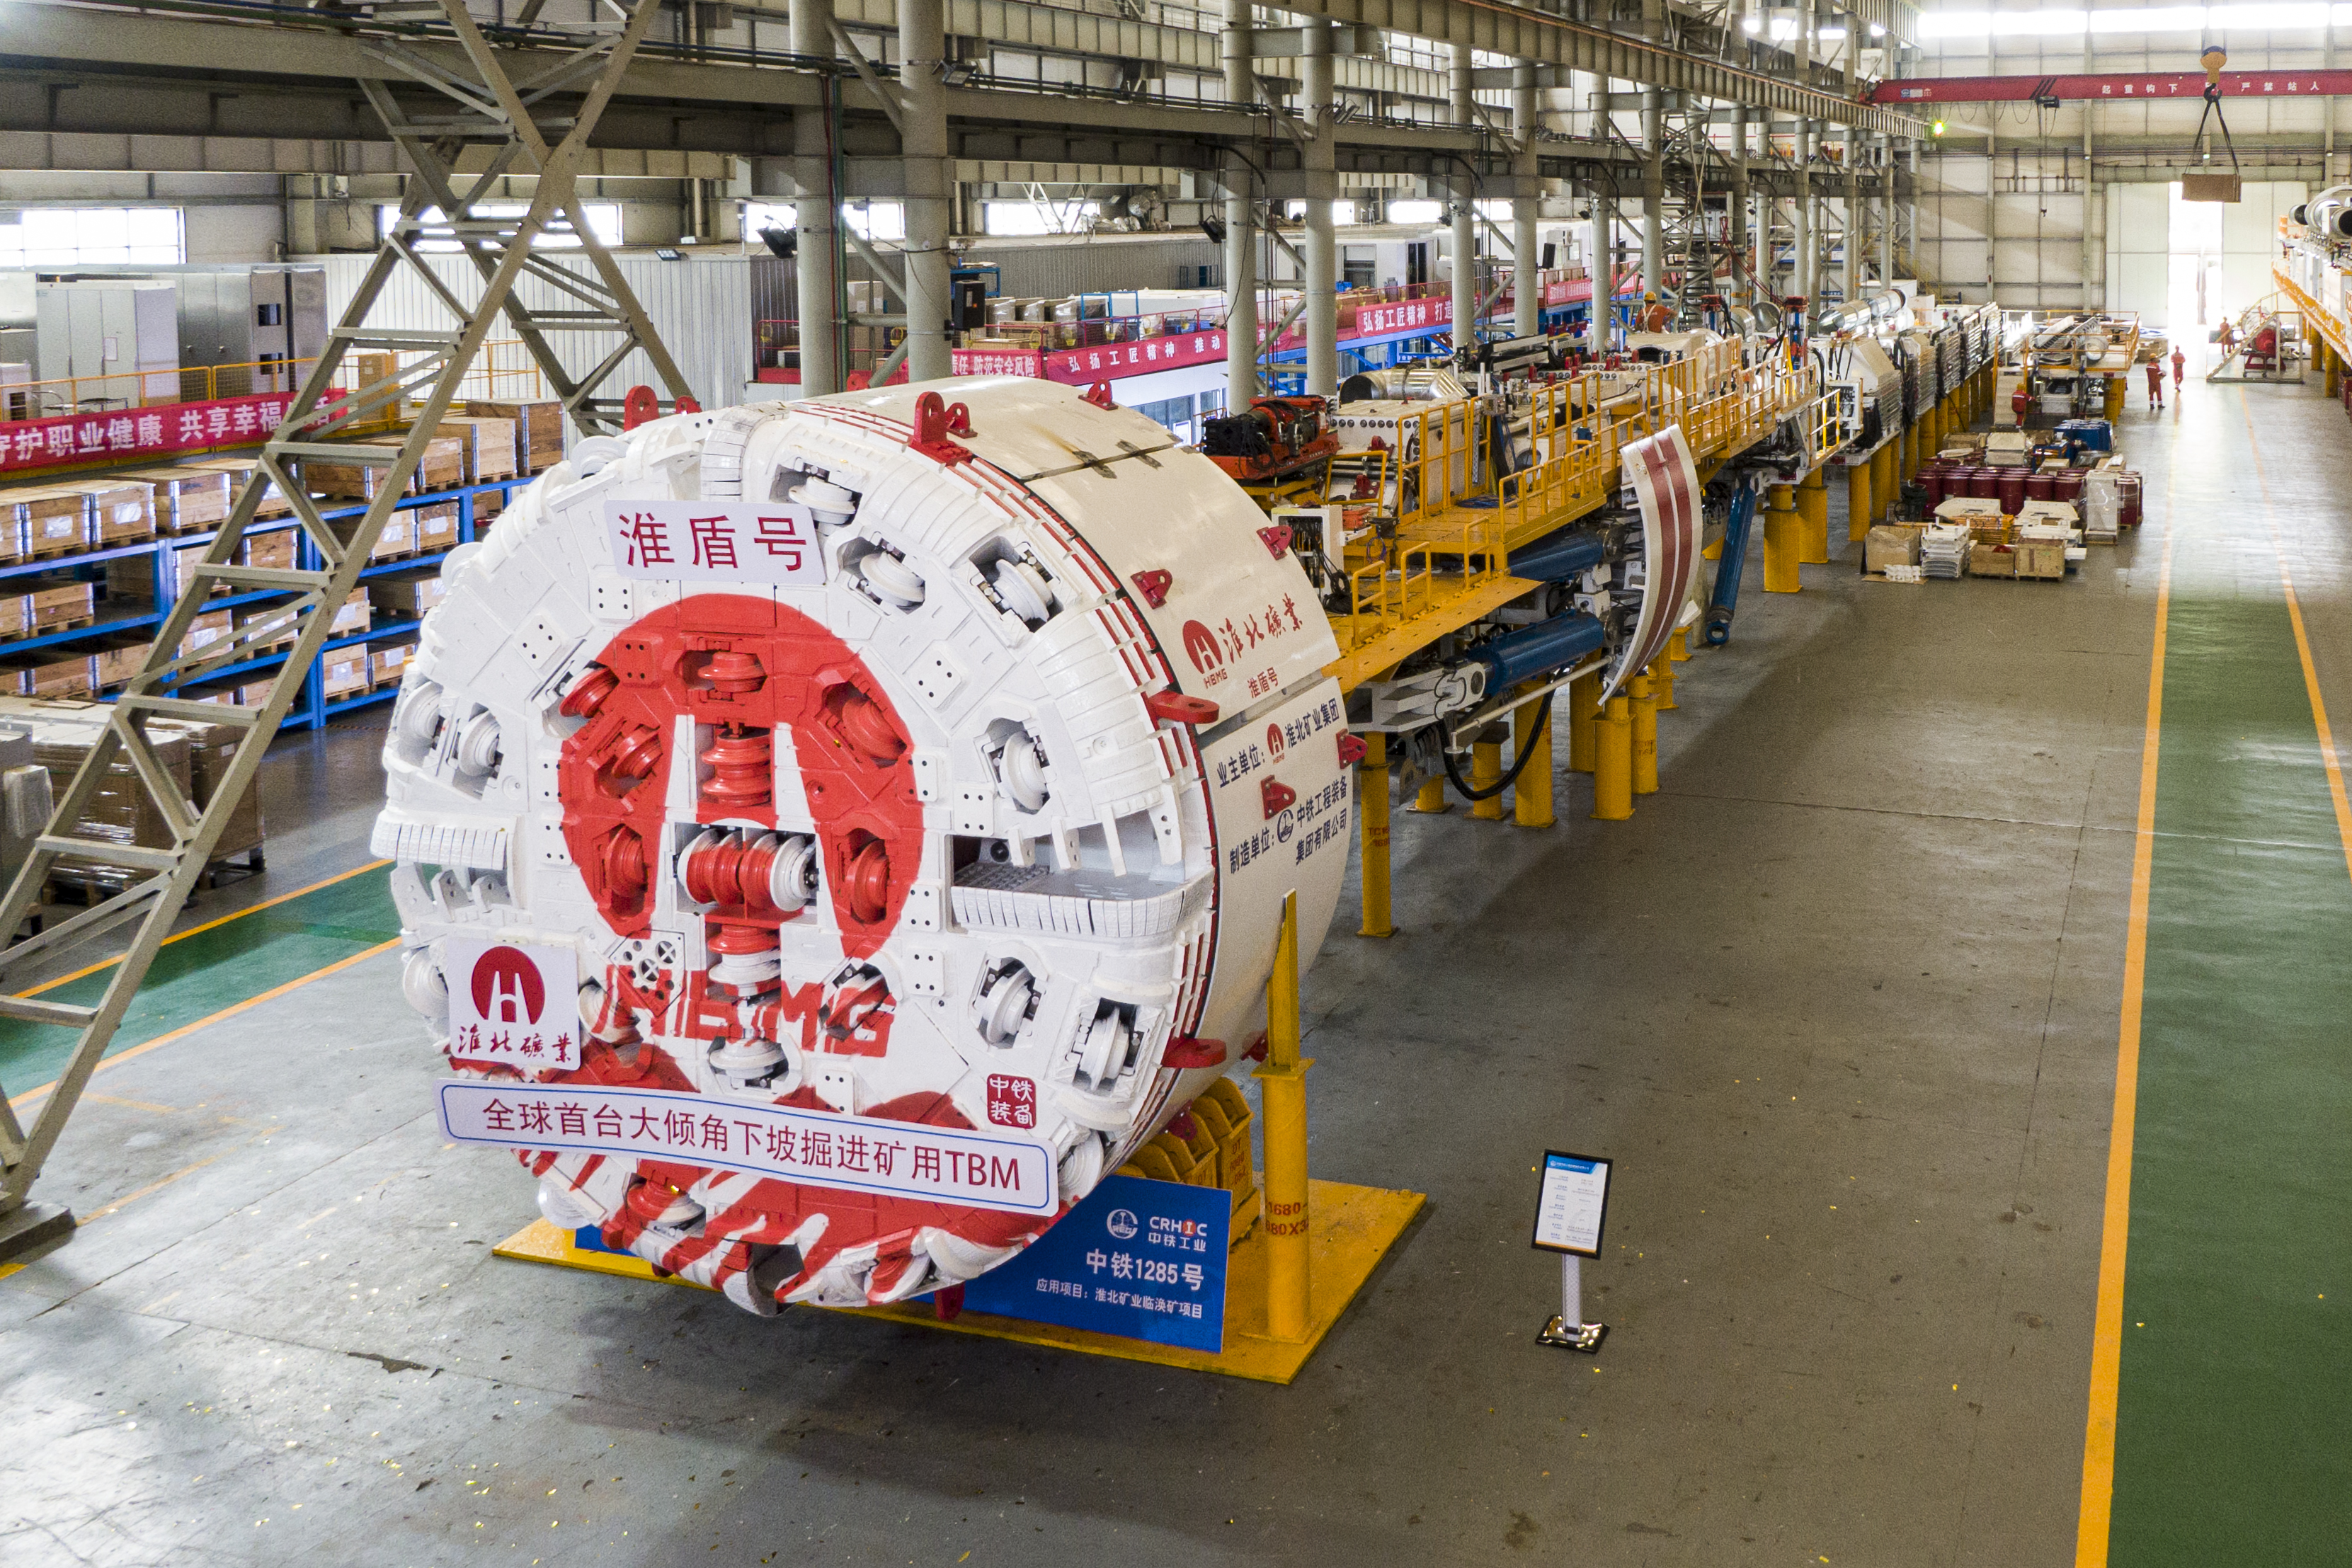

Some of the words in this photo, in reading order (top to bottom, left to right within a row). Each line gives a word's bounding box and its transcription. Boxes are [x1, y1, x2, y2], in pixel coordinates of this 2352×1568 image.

[1362, 303, 1426, 333] 弘扬工匠精神
[974, 355, 1035, 377] 防范安全风险
[1068, 341, 1175, 372] 弘扬工匠精神
[1194, 335, 1221, 353] 推动
[618, 511, 807, 572] 淮盾号
[1204, 668, 1228, 689] HBMG
[1248, 667, 1279, 699] 淮盾号
[1285, 697, 1340, 748] 淮北矿业集团
[1296, 775, 1347, 828] 中铁工程装备
[1296, 808, 1347, 866] 集团有限公司
[482, 1098, 1020, 1191] 全球首台大倾角下坡掘进矿用TBM
[1148, 1232, 1206, 1252] 中铁工业
[1149, 1216, 1208, 1237] CRHIC
[1086, 1249, 1204, 1291] 中铁1285号
